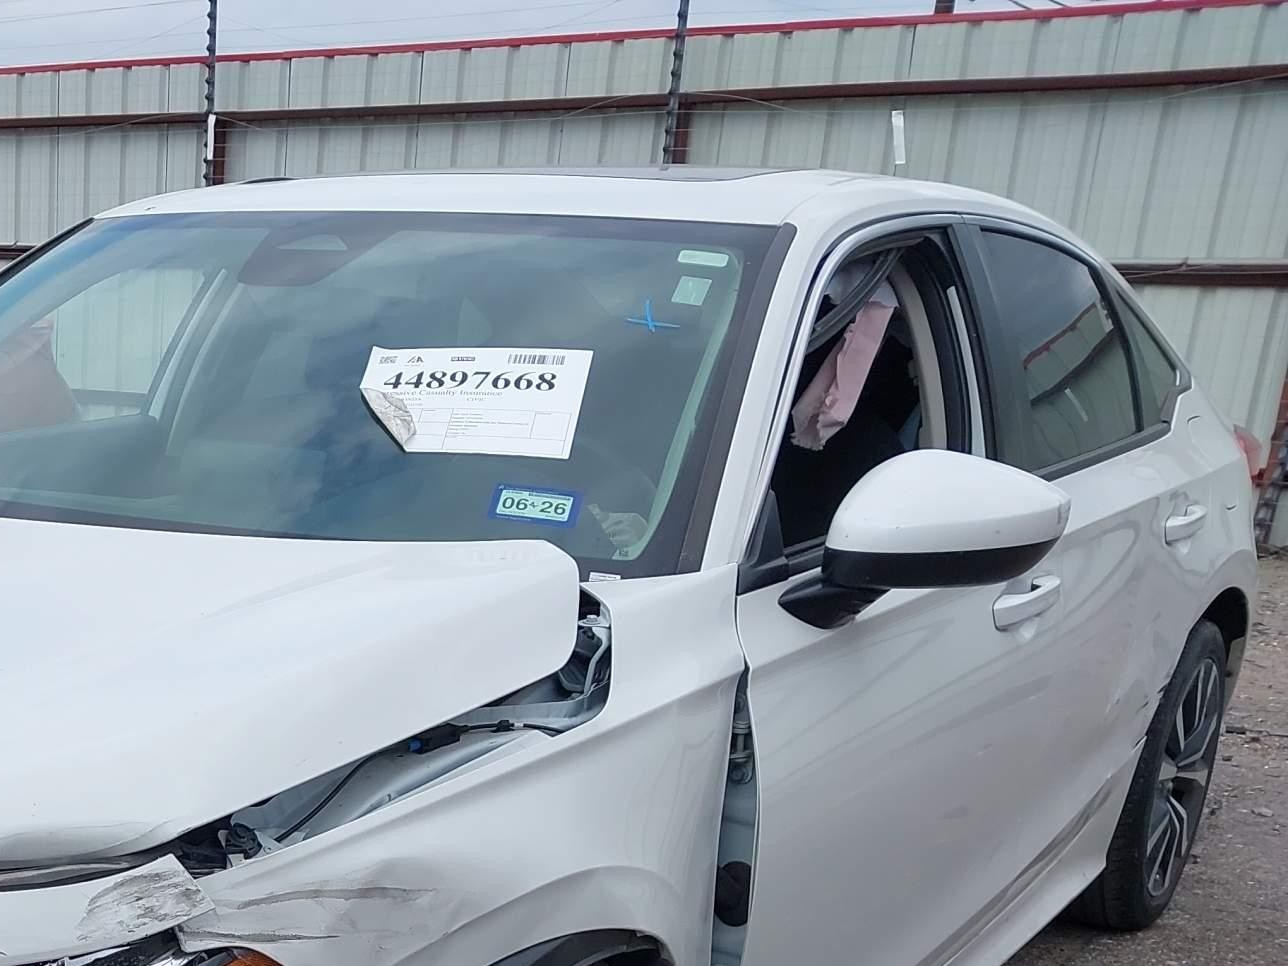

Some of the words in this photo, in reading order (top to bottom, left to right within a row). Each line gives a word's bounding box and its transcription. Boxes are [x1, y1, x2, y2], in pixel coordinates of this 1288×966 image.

[383, 370, 557, 391] 44897668
[502, 496, 529, 511] 06
[539, 501, 568, 516] 26
